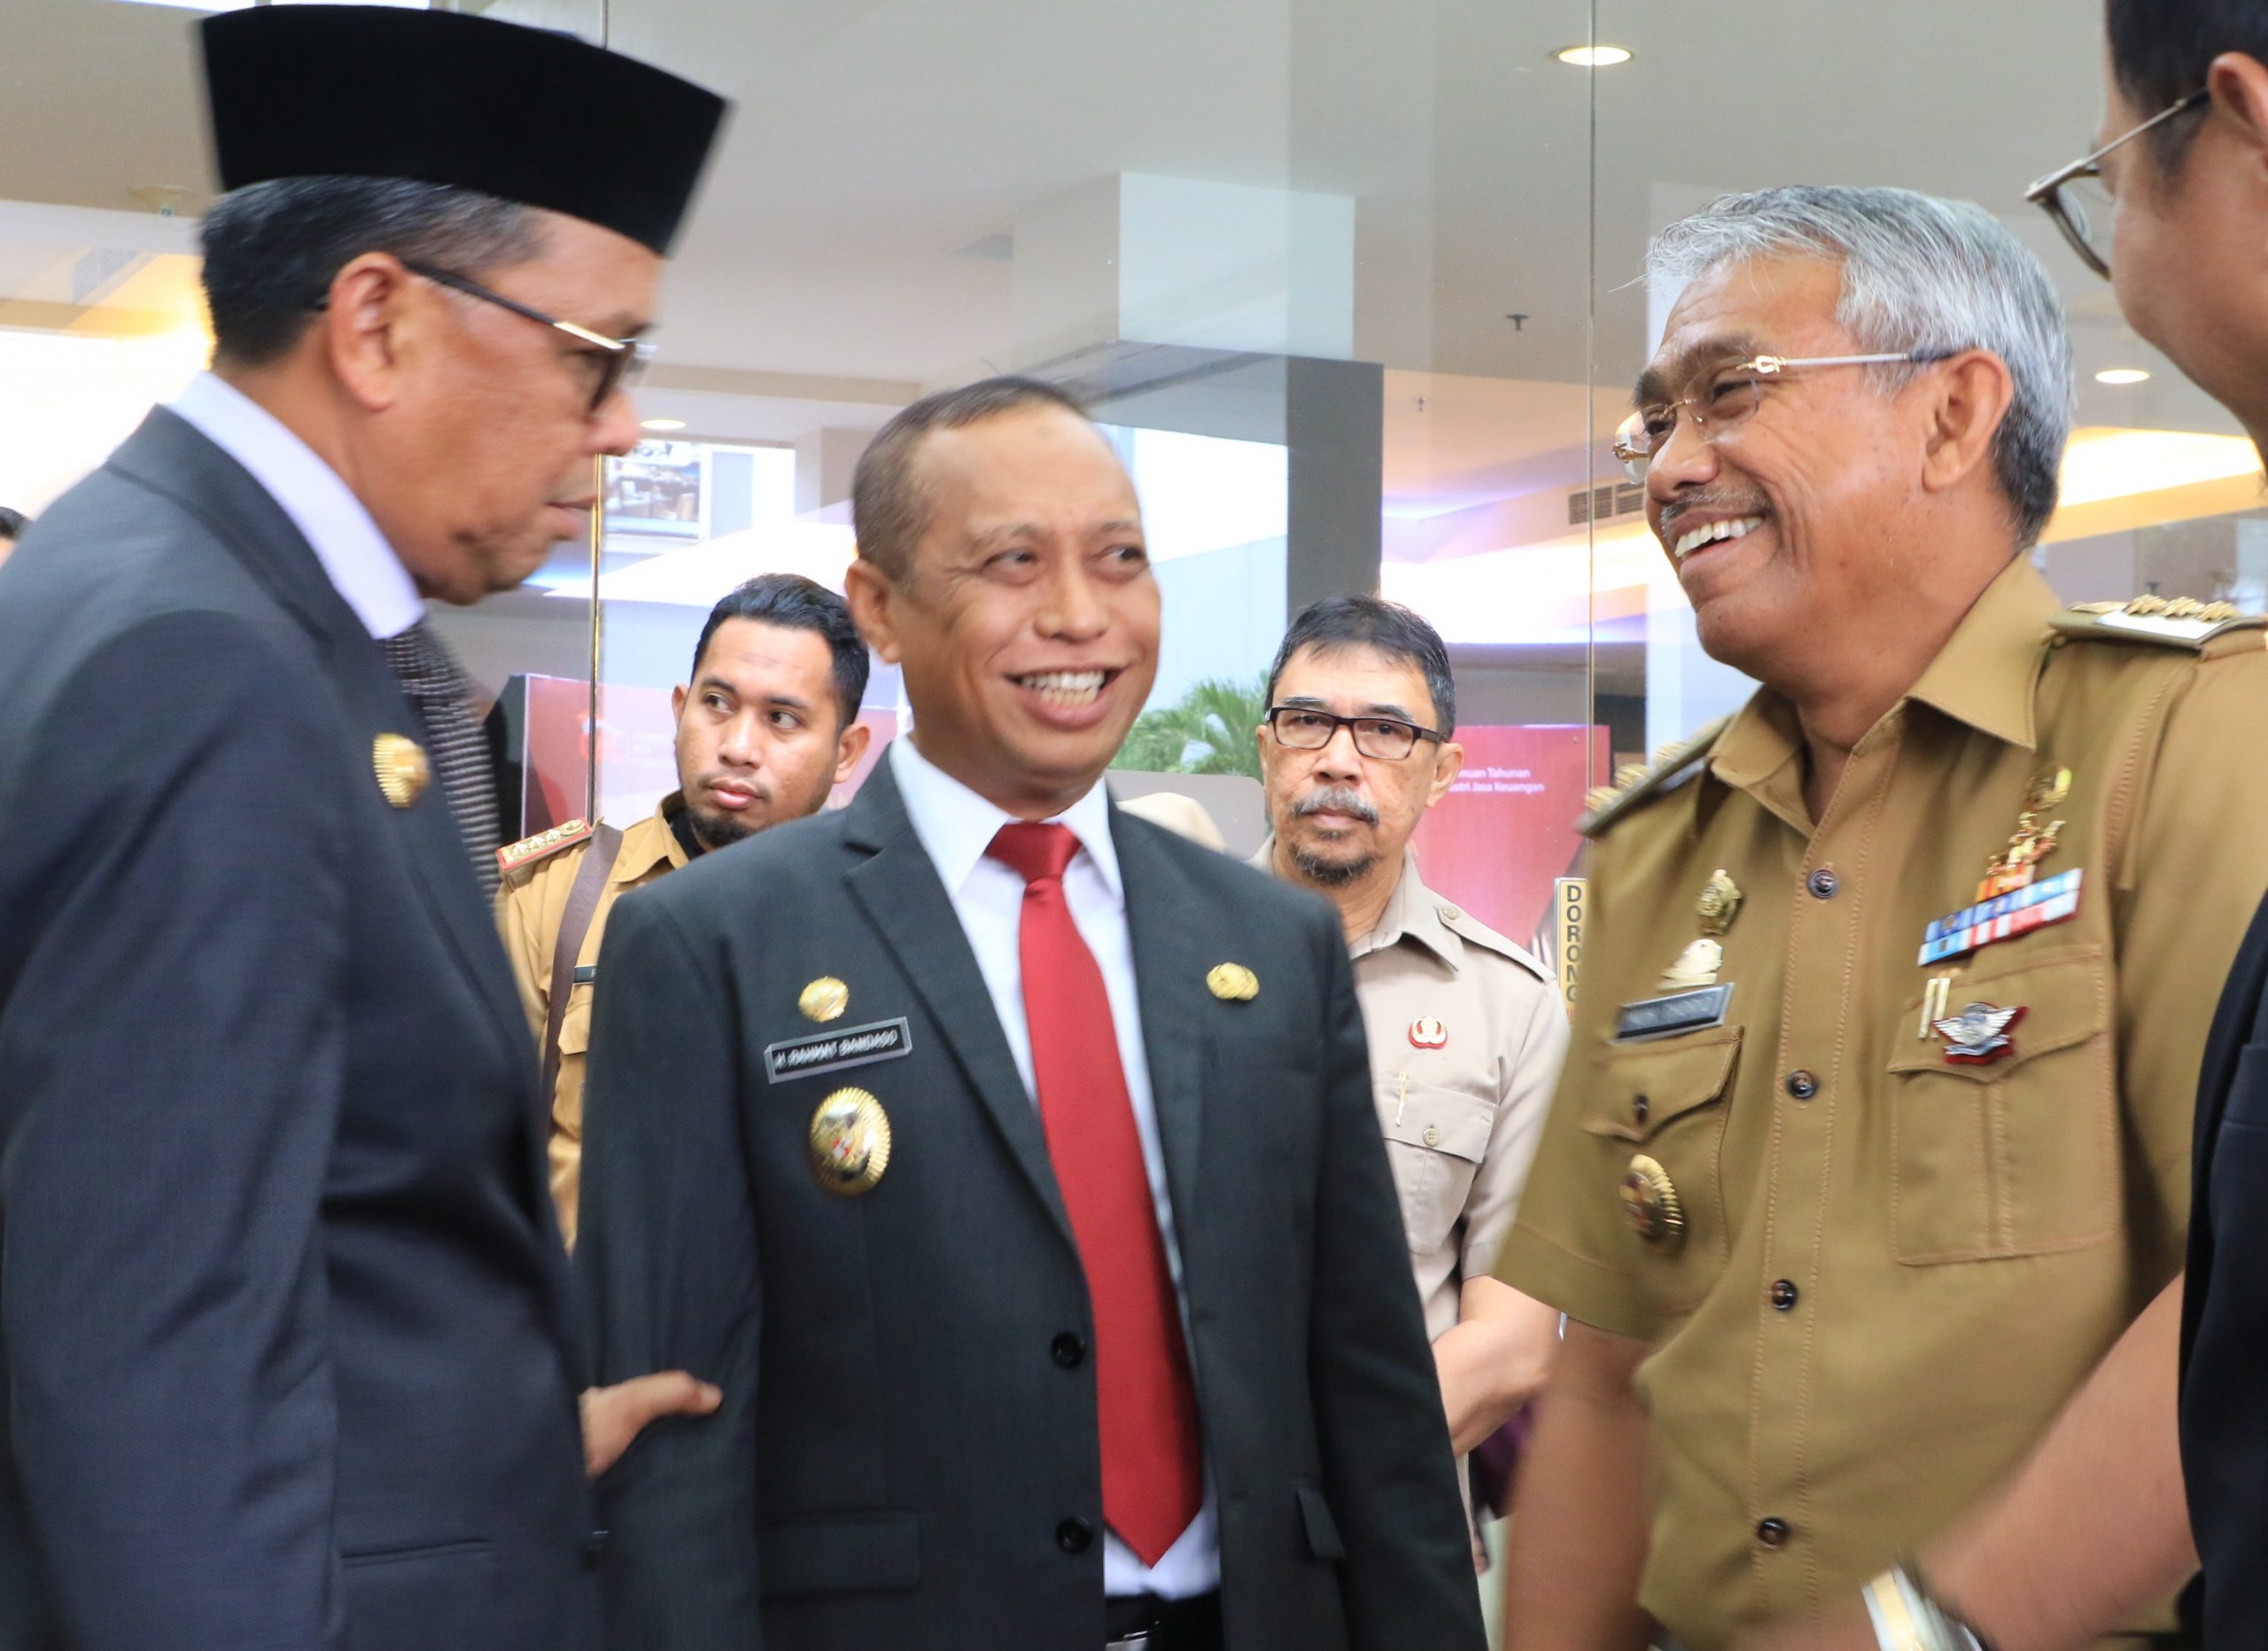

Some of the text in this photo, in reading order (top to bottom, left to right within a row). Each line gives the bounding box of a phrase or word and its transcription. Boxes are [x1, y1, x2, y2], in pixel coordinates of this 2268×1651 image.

[1487, 767, 1531, 779] Tahunan
[1472, 782, 1493, 792] Jasa
[1494, 782, 1545, 794] Keuangan
